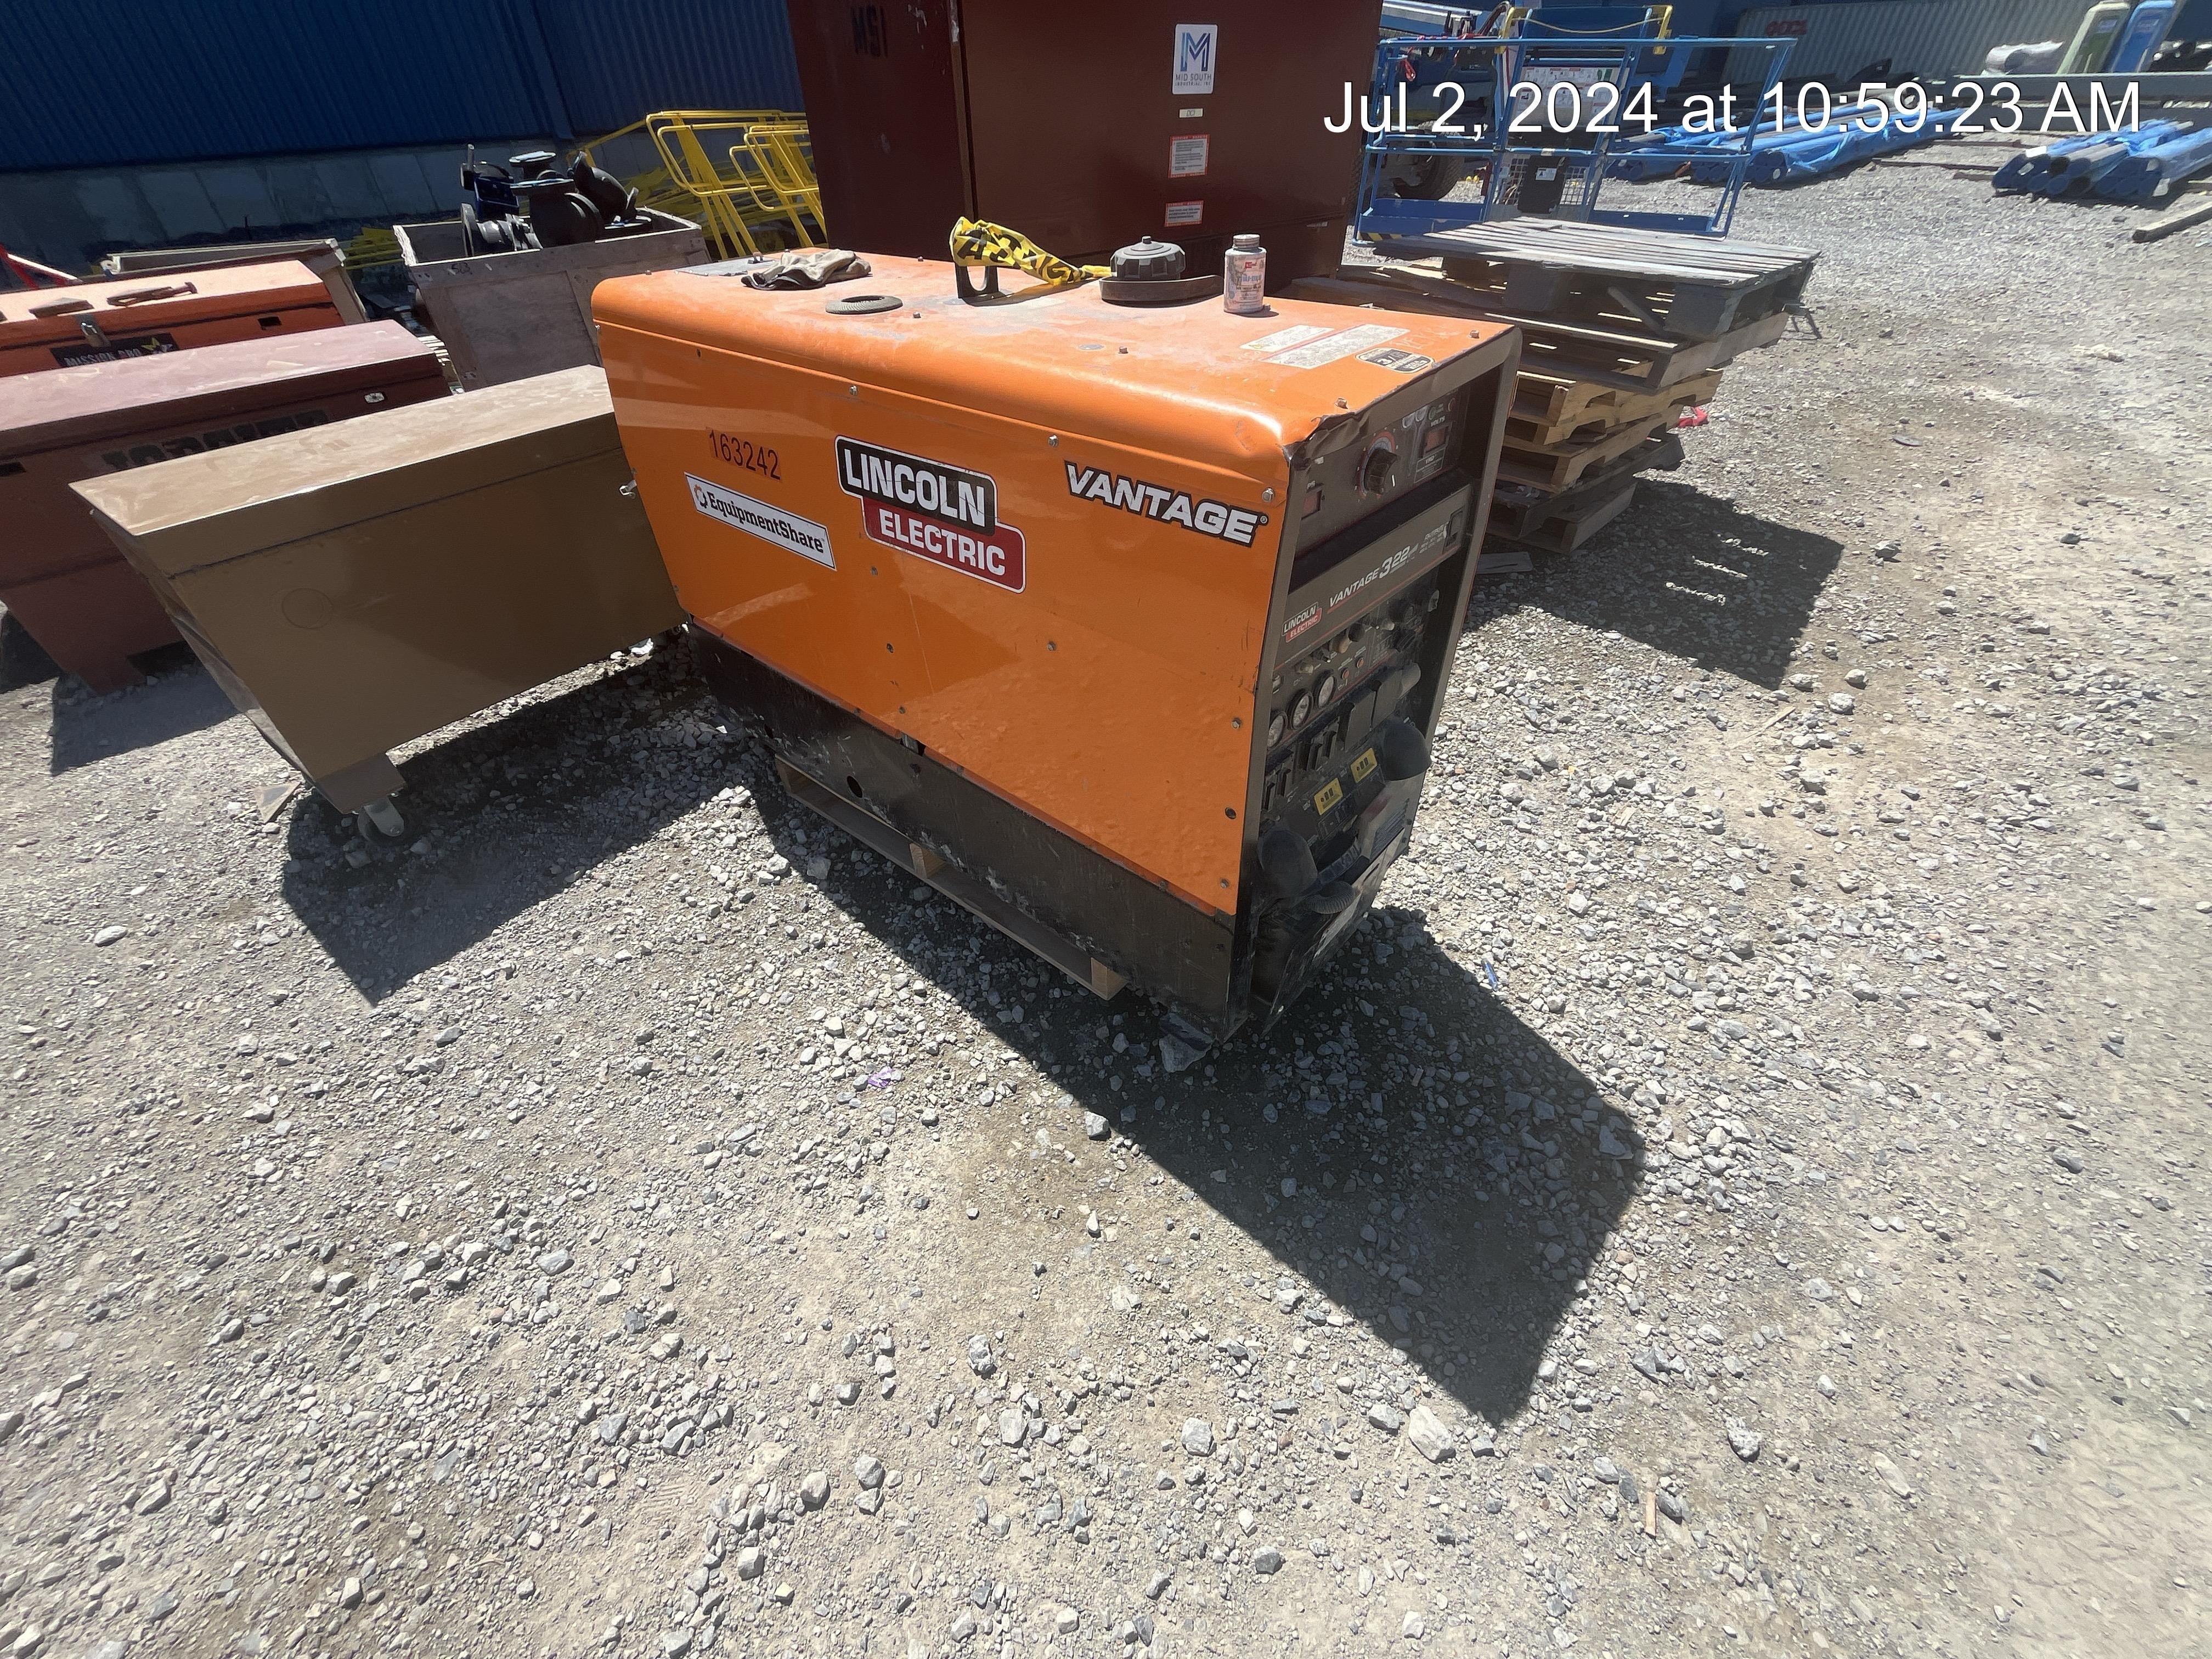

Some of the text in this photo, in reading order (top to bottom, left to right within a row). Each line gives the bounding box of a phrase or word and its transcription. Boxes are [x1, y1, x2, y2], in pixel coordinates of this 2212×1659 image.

[1175, 73, 1212, 81] MID SOUTH
[1430, 415, 1446, 427] VOLTS
[709, 430, 781, 481] 163242
[843, 448, 986, 528] LINCOLN
[706, 490, 824, 554] EquipmentShare
[879, 510, 1006, 577] ELECTRIC
[1329, 566, 1380, 607] VANTAGE
[1379, 545, 1410, 579] 322
[1283, 604, 1317, 632] LINCOLN
[1289, 614, 1318, 638] ELECTRIC
